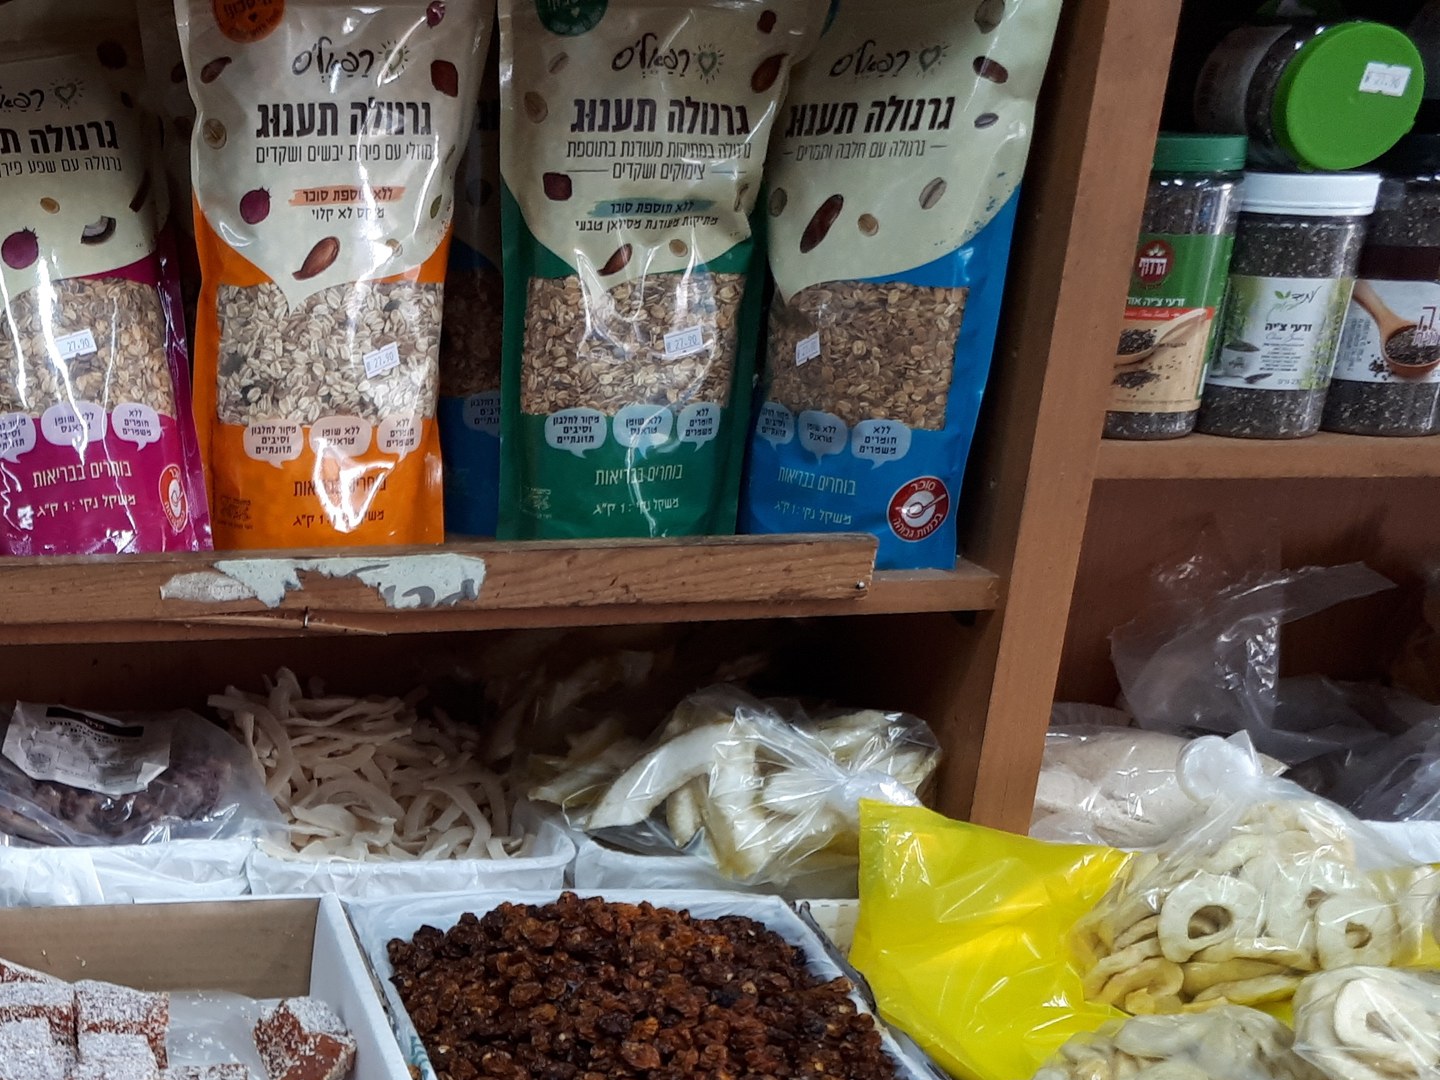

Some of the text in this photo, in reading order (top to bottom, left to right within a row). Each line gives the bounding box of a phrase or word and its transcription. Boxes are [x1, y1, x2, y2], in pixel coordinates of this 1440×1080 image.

[256, 97, 432, 139] גרנולה תענוג
[570, 96, 750, 136] גרנולה תענוג
[785, 96, 956, 138] גרנולה תענוג
[29, 120, 120, 156] גרנולה
[256, 142, 433, 166] מוזלי עם יבשים ושקדים
[566, 140, 715, 160] במתיקות מעודנת בתוספת
[796, 139, 926, 161] גרנולה עם חלבה ותמרים
[29, 160, 56, 175] שפע
[62, 159, 80, 173] עם
[612, 162, 706, 182] צימוקים ושקדים
[303, 187, 394, 203] ללא סוכר
[611, 202, 694, 214] ללא תוספת סוכר
[311, 207, 353, 223] לא קלוי
[575, 220, 603, 232] טבעי
[645, 218, 679, 230] מעודנת
[682, 216, 719, 228] מתיקות
[1291, 323, 1313, 332] זרעי
[128, 409, 142, 418] ללא
[695, 408, 709, 417] ללא
[123, 418, 149, 429] חומרים
[552, 415, 600, 426] מקור לחלבון
[625, 416, 662, 427] ללא שומן
[689, 417, 713, 427] חומרים
[122, 426, 152, 437] משמרים
[251, 425, 297, 436] מקור לחלבון
[322, 426, 360, 438] ללא שומן
[562, 425, 592, 434] וסיבים
[685, 426, 713, 437] משמרים
[822, 425, 837, 434] ללא
[873, 425, 892, 434] ללא
[261, 436, 290, 445] וסיבים
[556, 434, 594, 444] תזונתיים
[864, 435, 897, 444] חומרים
[255, 445, 292, 454] תזונתיים
[859, 444, 897, 455] משמרים
[32, 460, 133, 489] בוחרים בבריאות
[648, 464, 683, 481] בוחרים
[778, 465, 857, 496] בוחרים בבריאות
[910, 480, 936, 491] סוכר
[102, 492, 137, 508] משקל
[36, 502, 59, 518] ק"ג
[592, 497, 679, 517] משקל ק"ג
[773, 500, 853, 525] משקל נקי ק"ג
[292, 514, 316, 528] ק"ג
[893, 513, 944, 538] בכמות גבוהה
